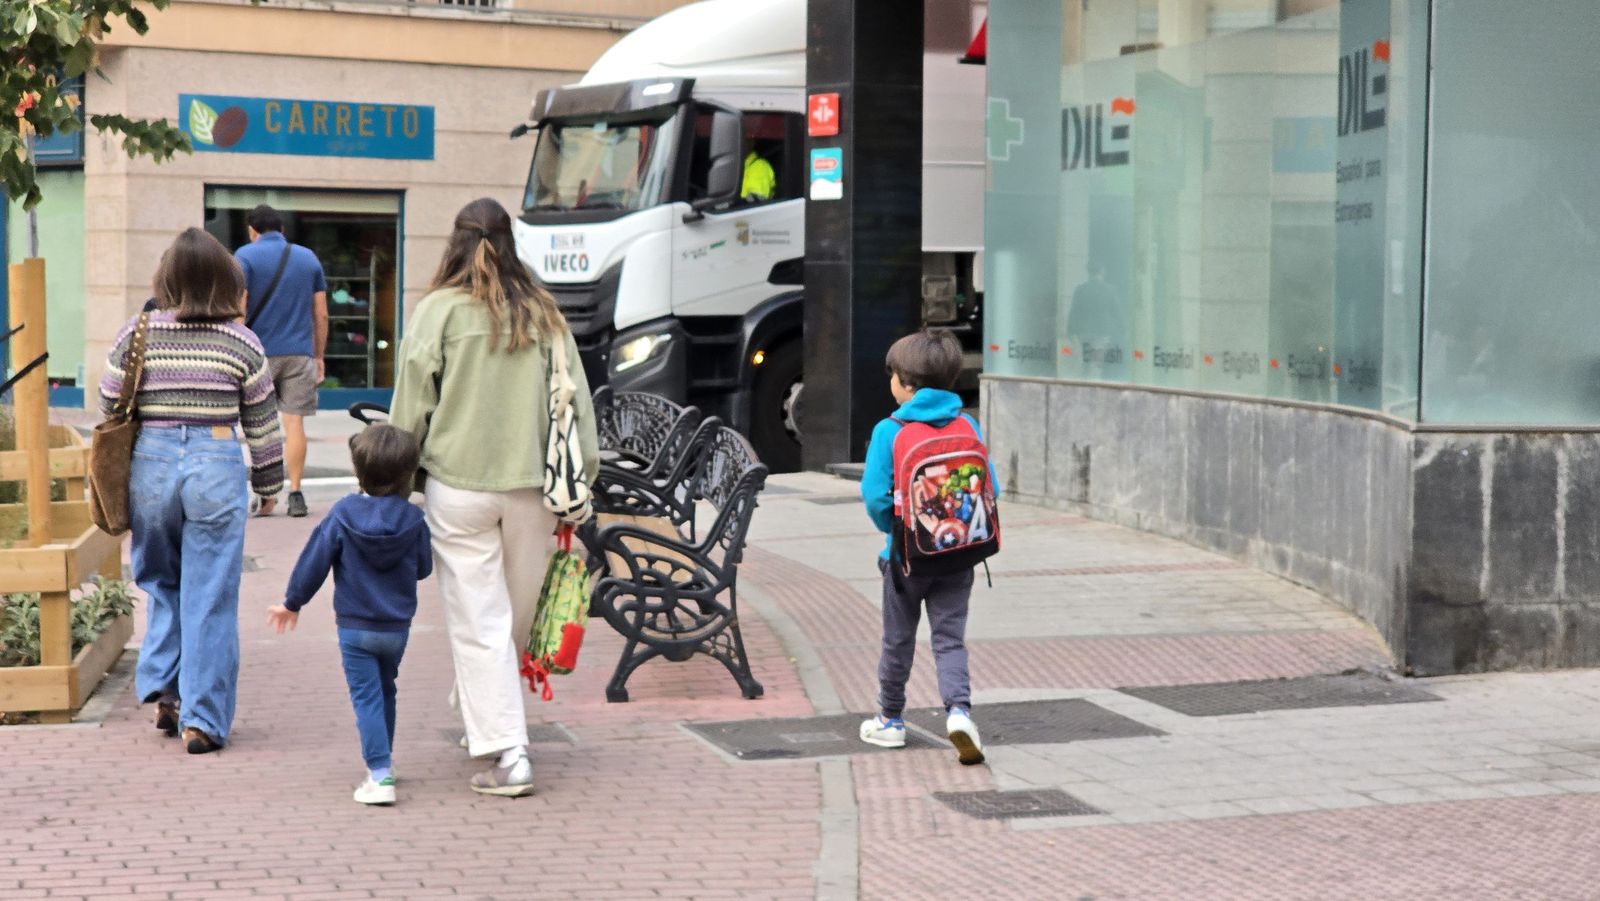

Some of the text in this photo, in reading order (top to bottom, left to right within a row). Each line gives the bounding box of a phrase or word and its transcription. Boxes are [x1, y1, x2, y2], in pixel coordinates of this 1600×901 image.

[265, 101, 420, 139] CARRETO
[544, 253, 589, 273] IVECO
[1008, 340, 1052, 363] Español
[1083, 342, 1122, 365] Enish
[1154, 346, 1193, 371] Español
[1223, 351, 1260, 378] English
